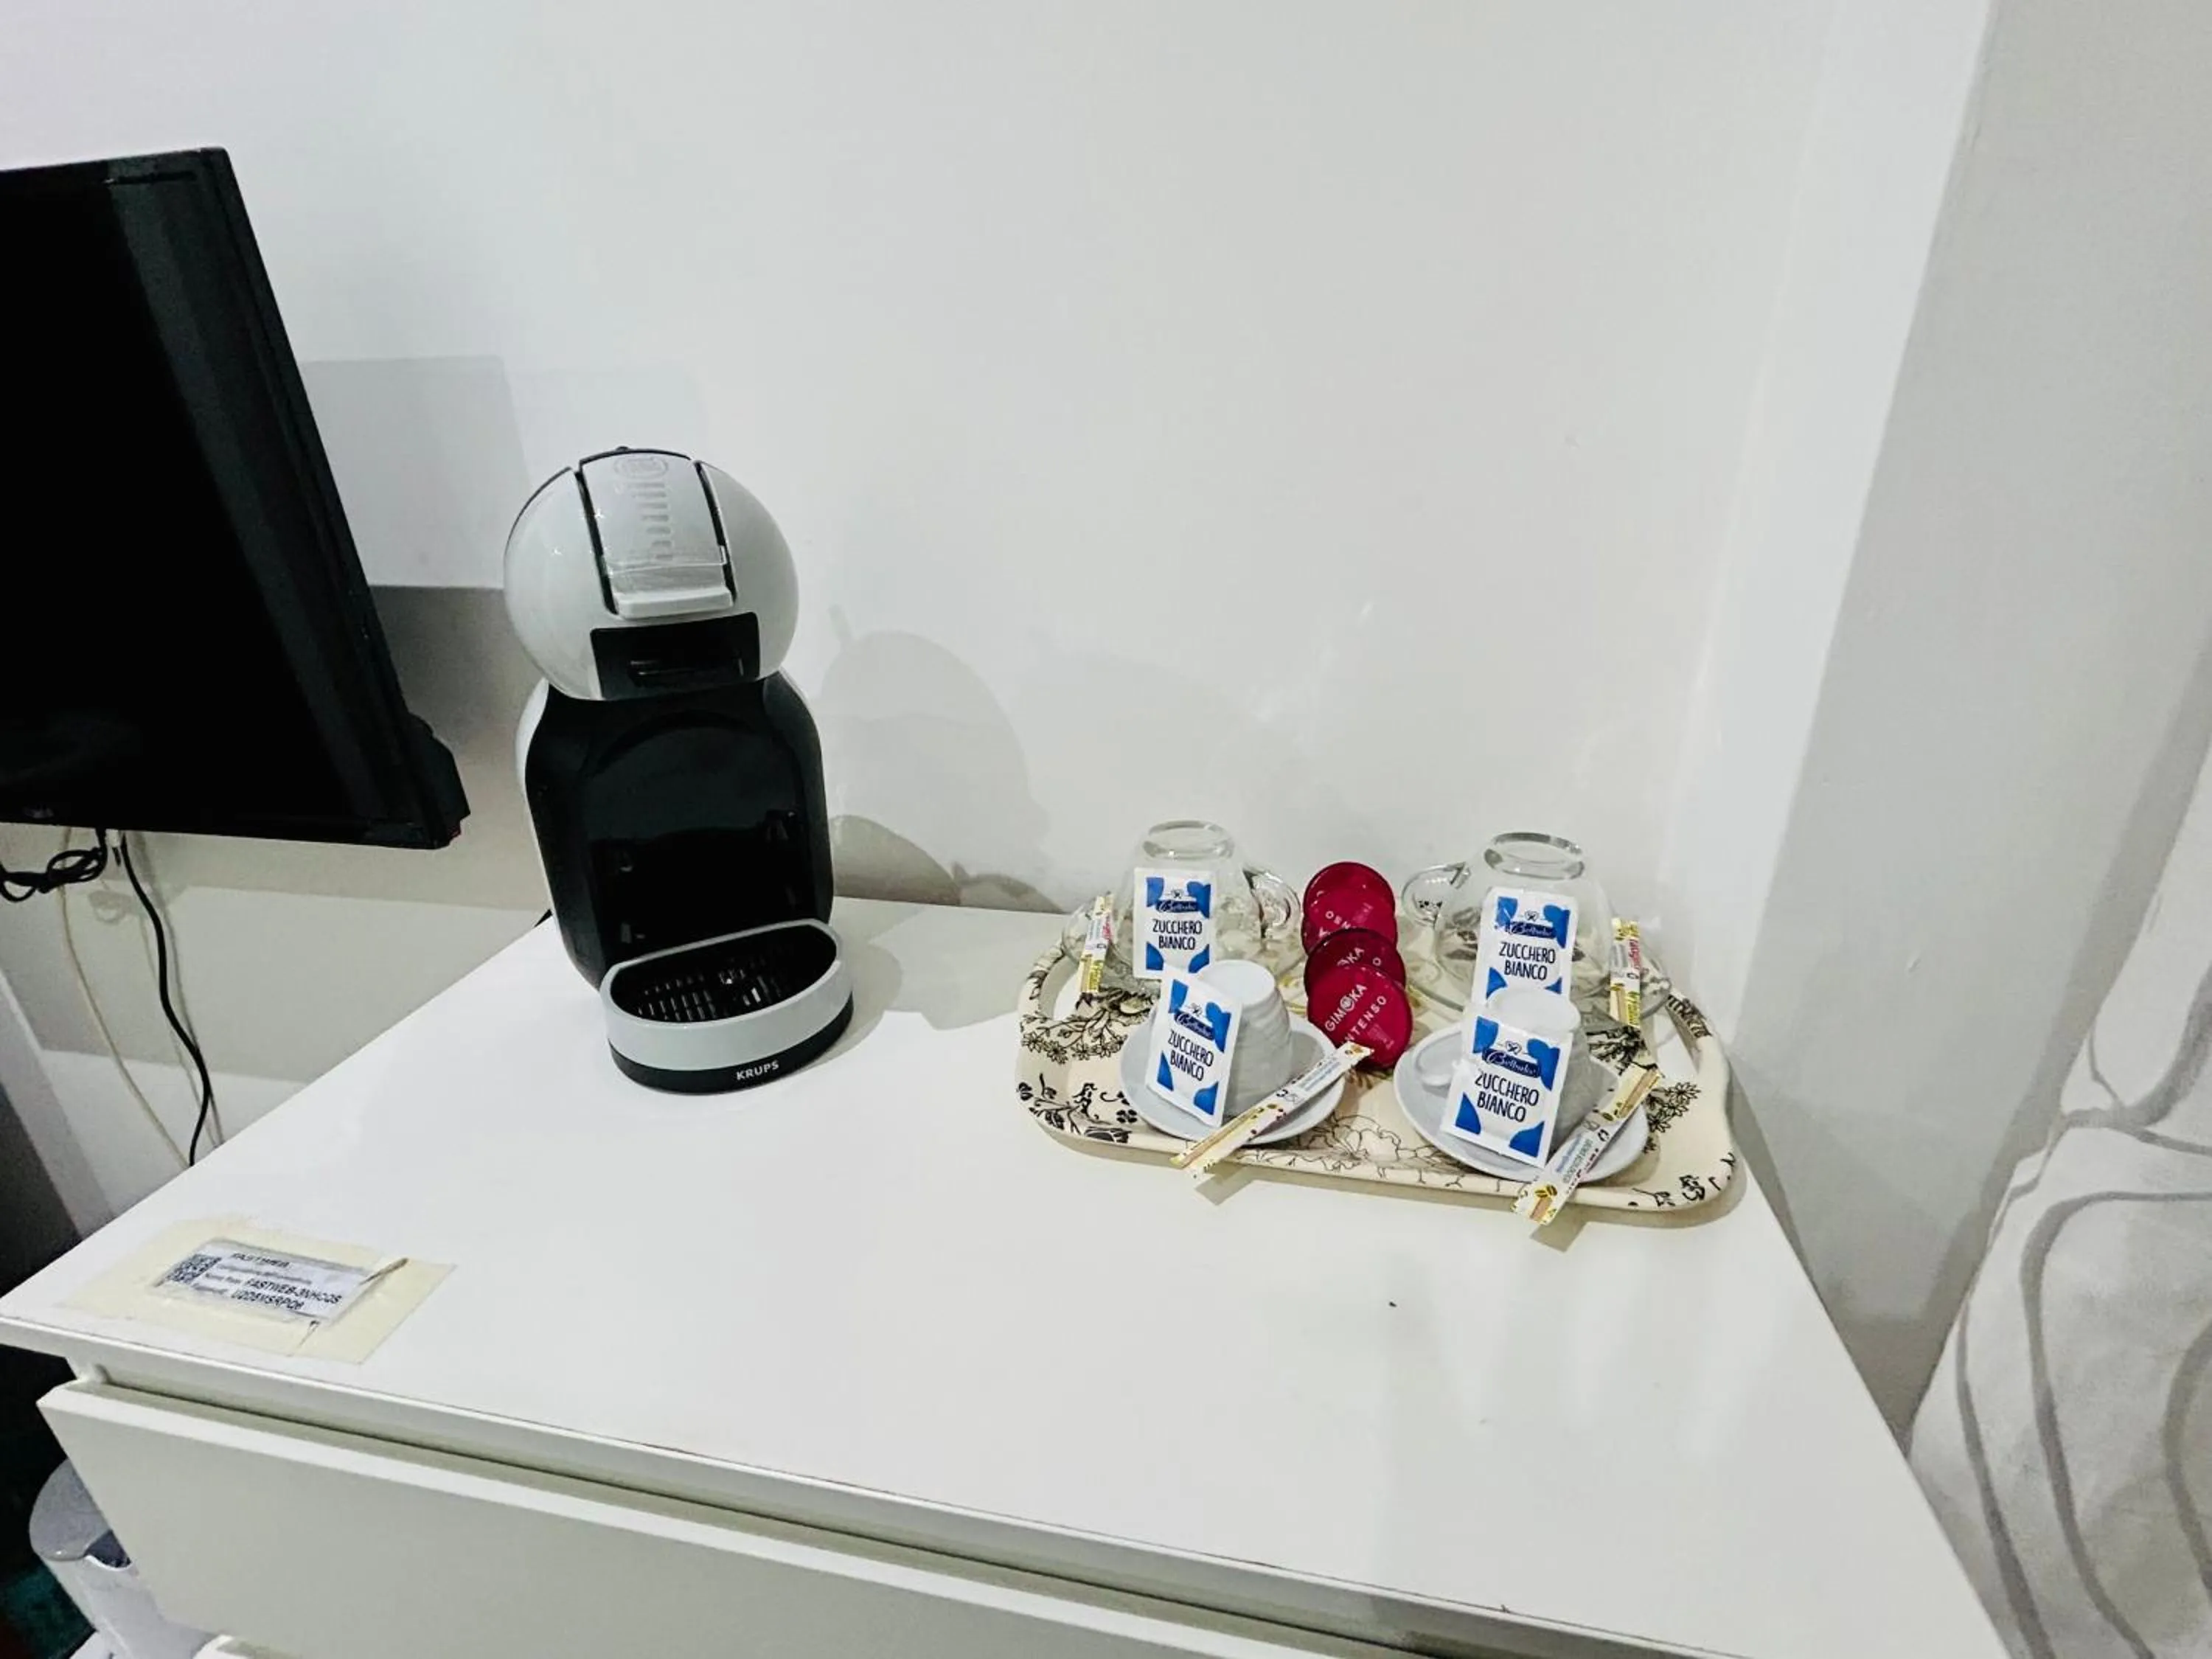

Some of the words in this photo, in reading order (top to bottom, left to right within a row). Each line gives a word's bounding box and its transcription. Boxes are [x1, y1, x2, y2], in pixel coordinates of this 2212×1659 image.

[1152, 918, 1203, 935] ZUCCHERO
[1158, 935, 1196, 950] BIANCO
[1499, 941, 1556, 964] ZUCCHERO
[1504, 959, 1548, 981] BIANCO
[1324, 984, 1368, 1032] GIMOKA
[1343, 995, 1387, 1043] NTENSO
[1167, 1029, 1214, 1067] ZUCCHERO
[736, 1060, 779, 1082] KRUPS
[1170, 1049, 1204, 1081] BIANCO
[1475, 1068, 1540, 1107] ZUCCHERO
[1477, 1091, 1526, 1122] BIANCO
